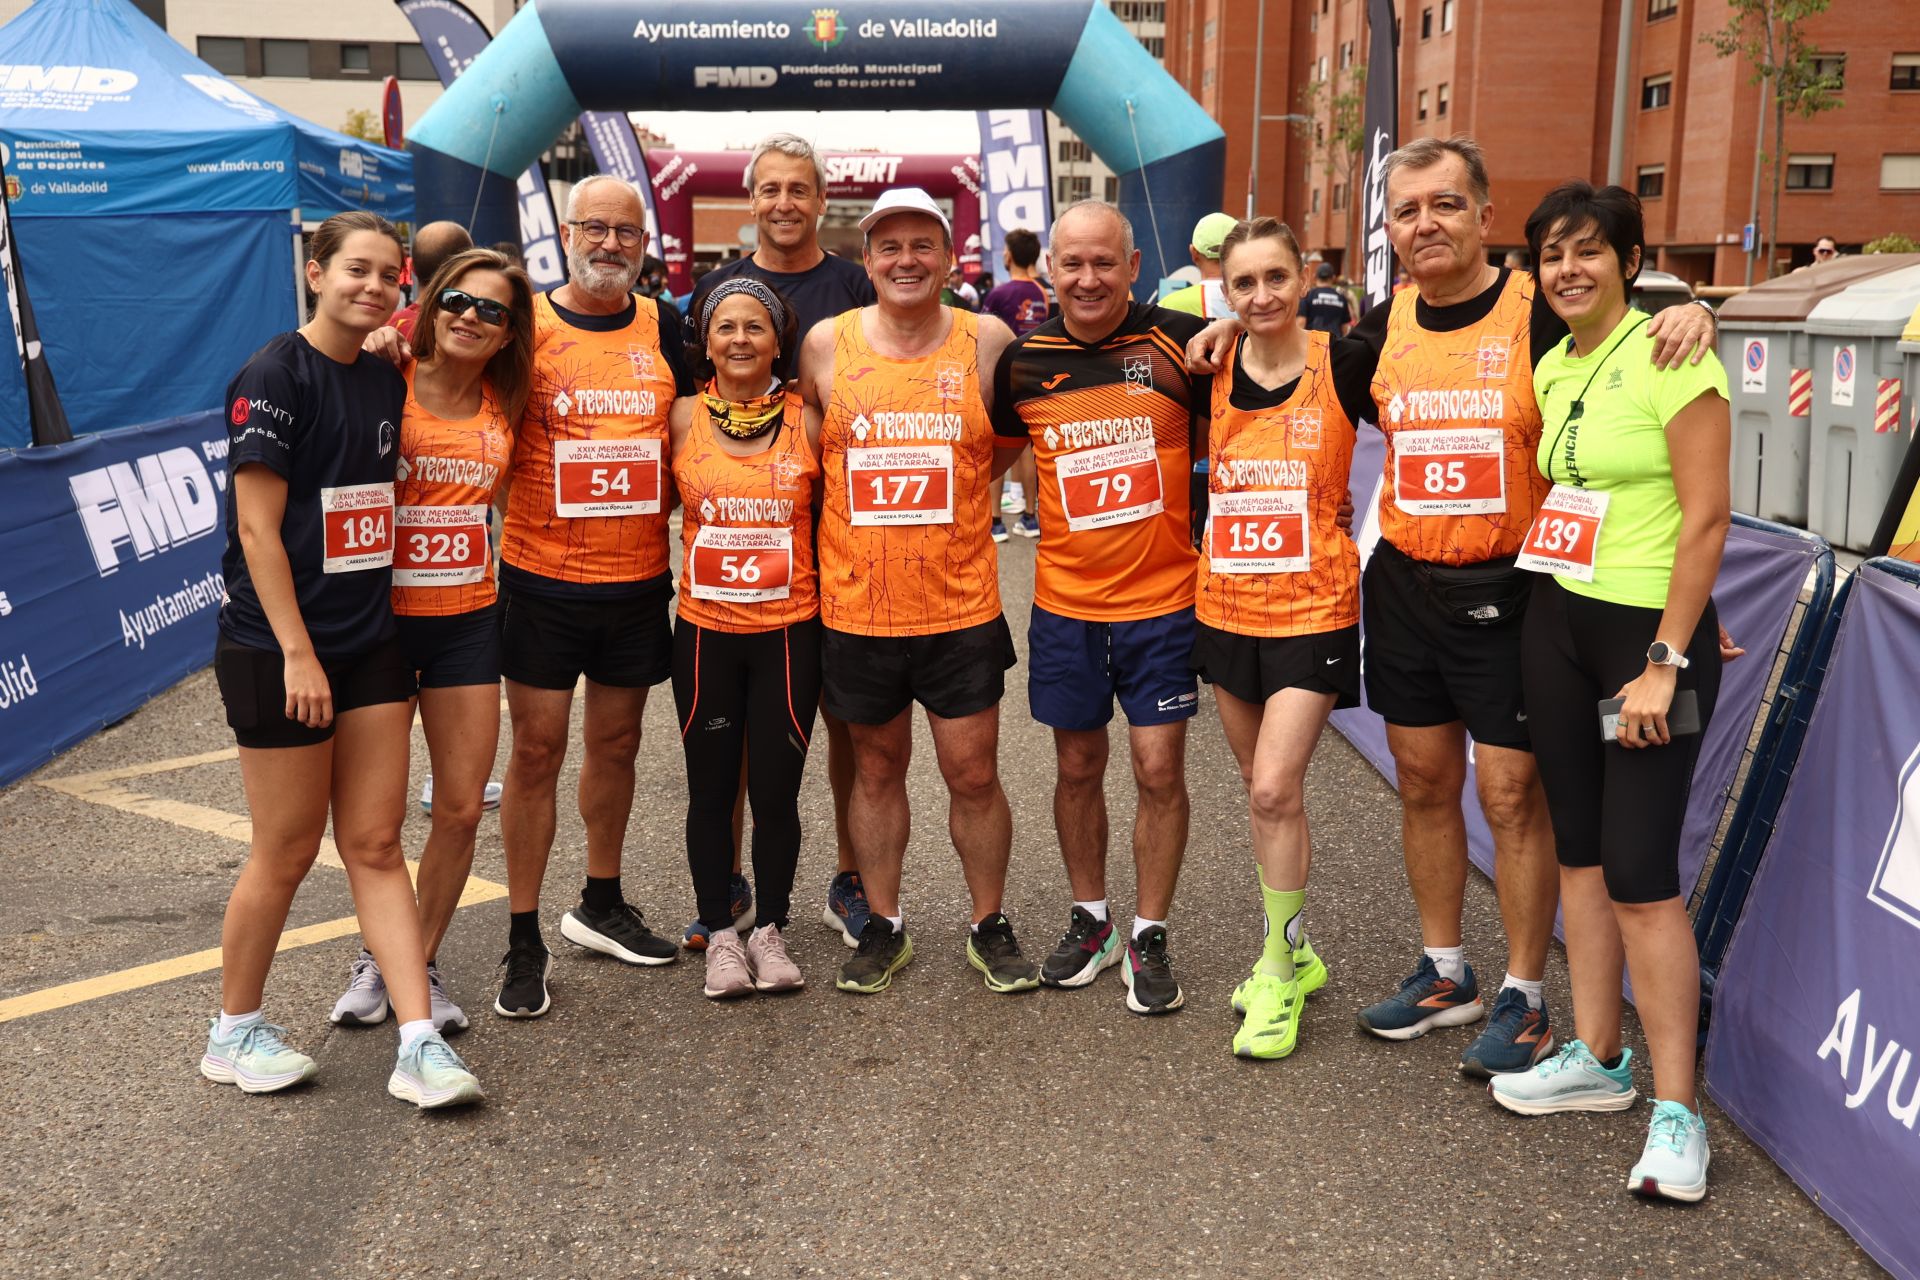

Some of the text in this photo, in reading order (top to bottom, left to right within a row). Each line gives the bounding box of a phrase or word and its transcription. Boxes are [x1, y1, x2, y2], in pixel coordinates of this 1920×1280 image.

[633, 18, 998, 43] Ayuntamiento de Valladolid
[0, 65, 138, 94] MD
[694, 64, 942, 88] FMD Fundación Municipal
[814, 79, 916, 88] de Deportes
[14, 141, 80, 150] Fundación
[15, 151, 82, 160] Municipal
[17, 161, 105, 171] de Deportes
[187, 160, 284, 174] www.fmdva.org
[651, 154, 683, 187] somos
[31, 181, 108, 193] de Valladolid
[661, 162, 698, 201] deporte
[575, 389, 656, 415] TECNOCASA
[1408, 389, 1503, 420] TECNOCASA
[873, 412, 962, 441] TECNOCASA
[1059, 416, 1154, 448] TECNOCASA
[1406, 442, 1490, 453] VIDAL-MATARRANZ
[1433, 436, 1480, 444] MEMORIAL
[569, 451, 650, 460] VIDAL-MATARRANZ
[859, 459, 940, 467] VIDAL-MATARRANZ
[886, 452, 931, 460] MEMORIAL
[1068, 452, 1148, 474] VIDAL-MATARRANZ
[1093, 447, 1138, 462] MEMORIAL
[415, 456, 498, 491] TECNOCASA
[590, 468, 630, 497] 54
[1230, 460, 1306, 487] TECNOCASA
[1424, 461, 1466, 493] 85
[356, 489, 385, 499] MEMORIAL
[870, 475, 929, 505] 177
[1089, 473, 1132, 507] 79
[1241, 497, 1284, 505] MEMORIAL
[69, 447, 218, 577] FMD
[429, 509, 471, 517] MEMORIAL
[717, 497, 794, 522] TECNOCASA
[343, 514, 386, 548] 184
[703, 539, 782, 547] VIDAL-MATARRANZ
[730, 533, 773, 541] MEMORIAL
[1229, 521, 1283, 552] 156
[1533, 517, 1581, 553] 139
[409, 533, 470, 563] 328
[720, 555, 761, 583] 56
[120, 571, 226, 650] Ayuntamiento
[1817, 989, 1920, 1129] Ayu
